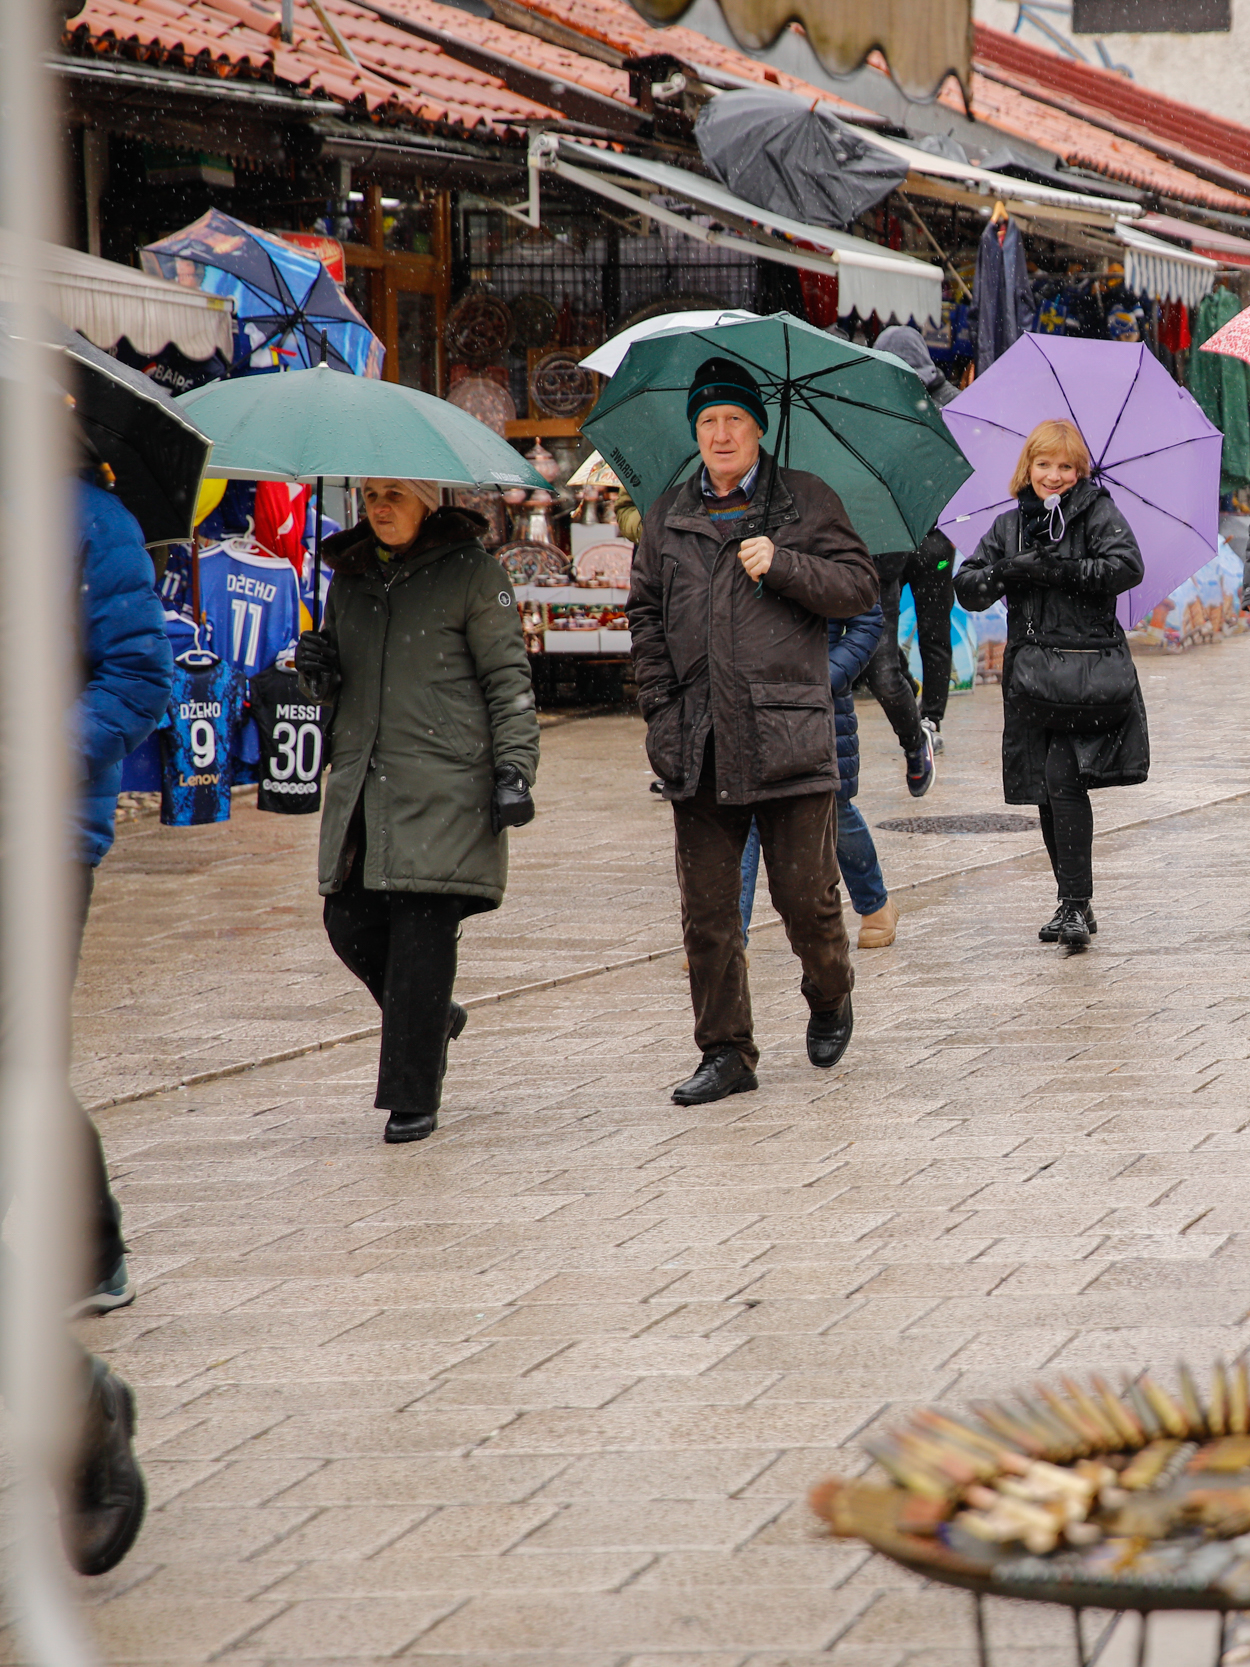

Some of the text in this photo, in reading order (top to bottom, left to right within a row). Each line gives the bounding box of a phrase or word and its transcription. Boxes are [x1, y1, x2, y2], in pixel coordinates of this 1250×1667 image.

[161, 569, 181, 600] 11
[226, 574, 277, 602] DŽEKO
[231, 599, 263, 667] 11
[179, 699, 222, 719] DŽEKO
[276, 704, 321, 721] MESSI
[190, 719, 216, 768] 9
[269, 721, 323, 782] 30
